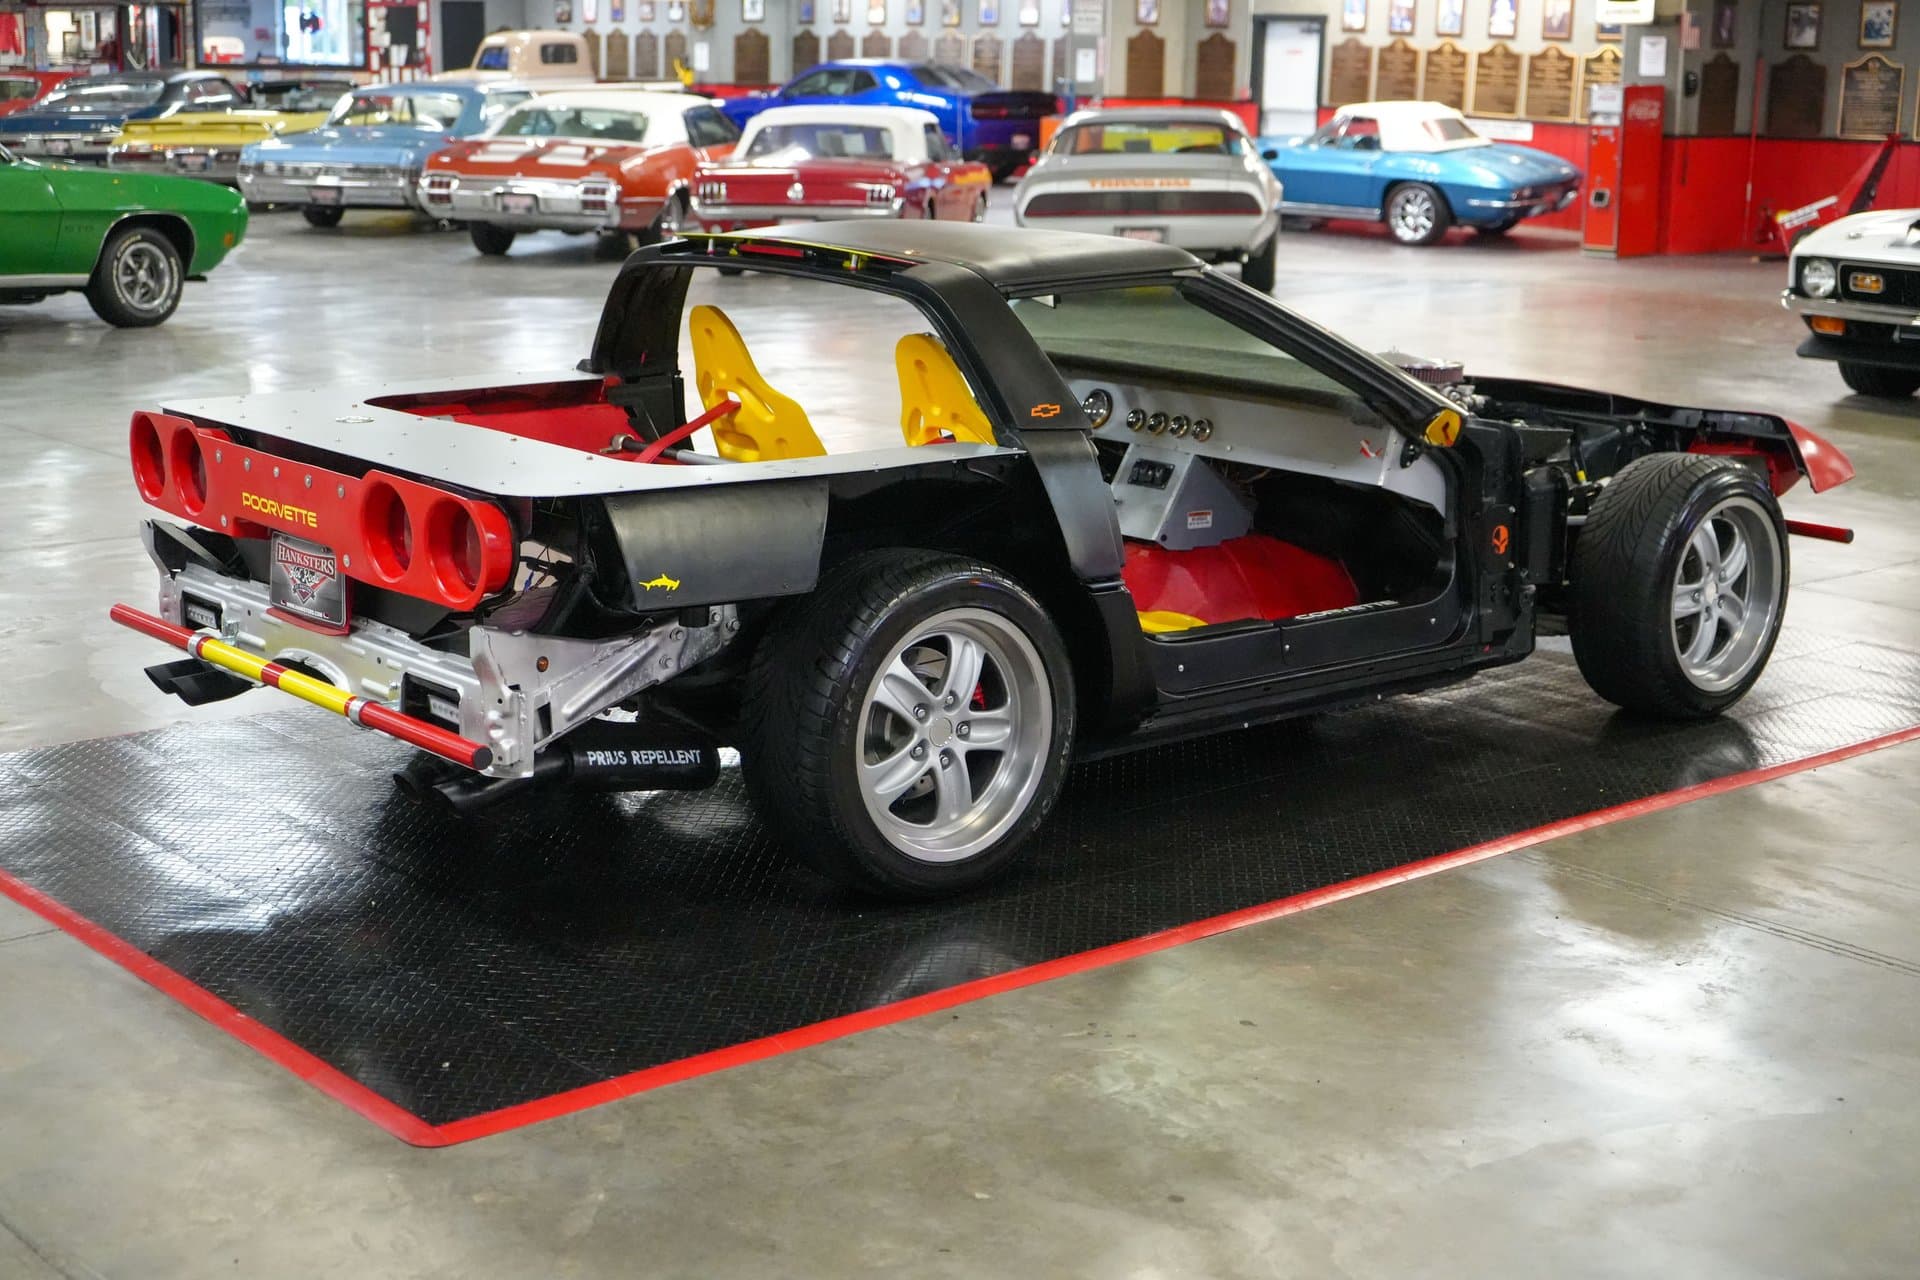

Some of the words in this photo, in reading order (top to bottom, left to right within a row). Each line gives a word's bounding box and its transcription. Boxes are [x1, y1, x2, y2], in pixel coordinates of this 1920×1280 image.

[242, 491, 318, 528] POORVETTE
[278, 544, 335, 576] HANKSTERS
[587, 750, 627, 766] PRIUS
[631, 749, 701, 766] REPELLENT
